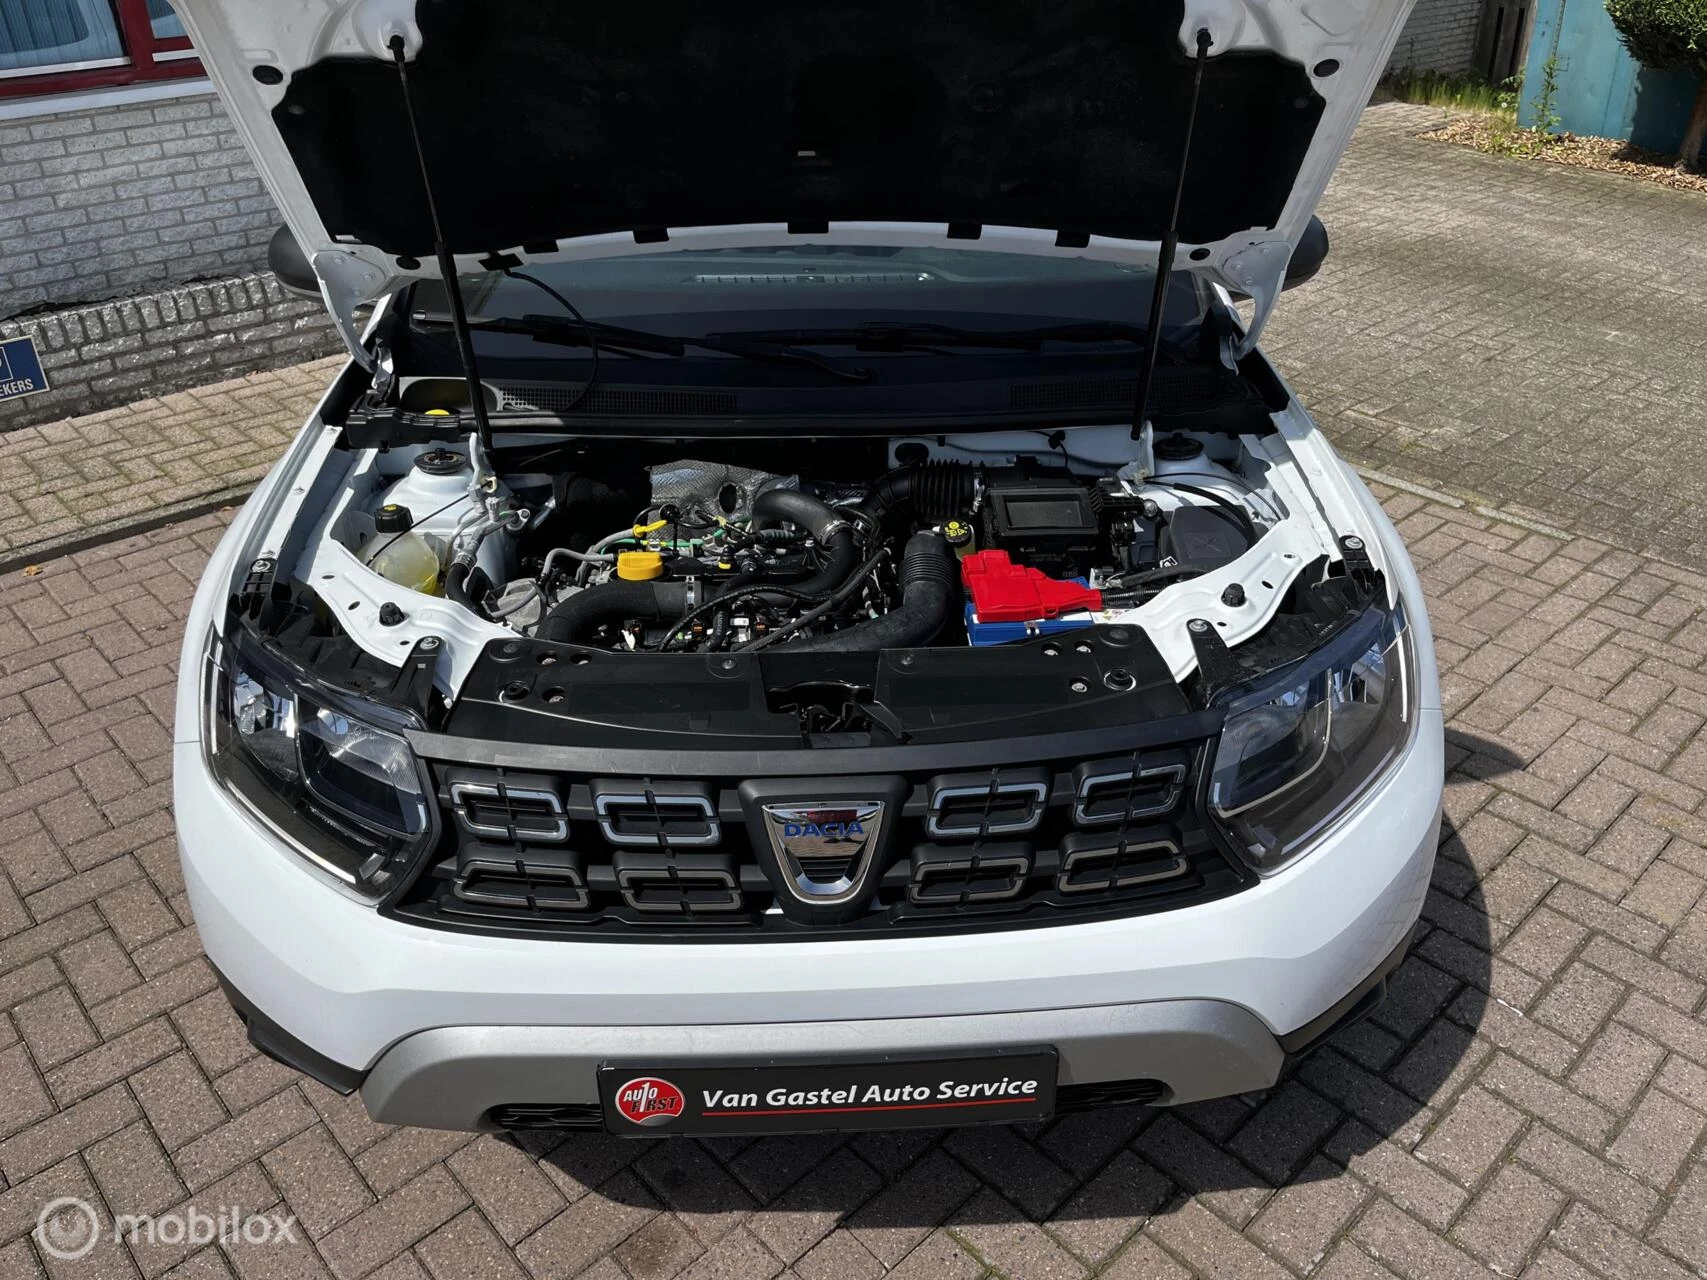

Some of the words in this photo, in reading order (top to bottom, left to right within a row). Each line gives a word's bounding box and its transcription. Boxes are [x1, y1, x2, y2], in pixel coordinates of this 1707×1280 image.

[784, 821, 864, 838] DACIA
[702, 1090, 758, 1108] Van
[766, 1084, 858, 1106] Gastel
[861, 1084, 930, 1103] Auto
[936, 1077, 1038, 1099] Service
